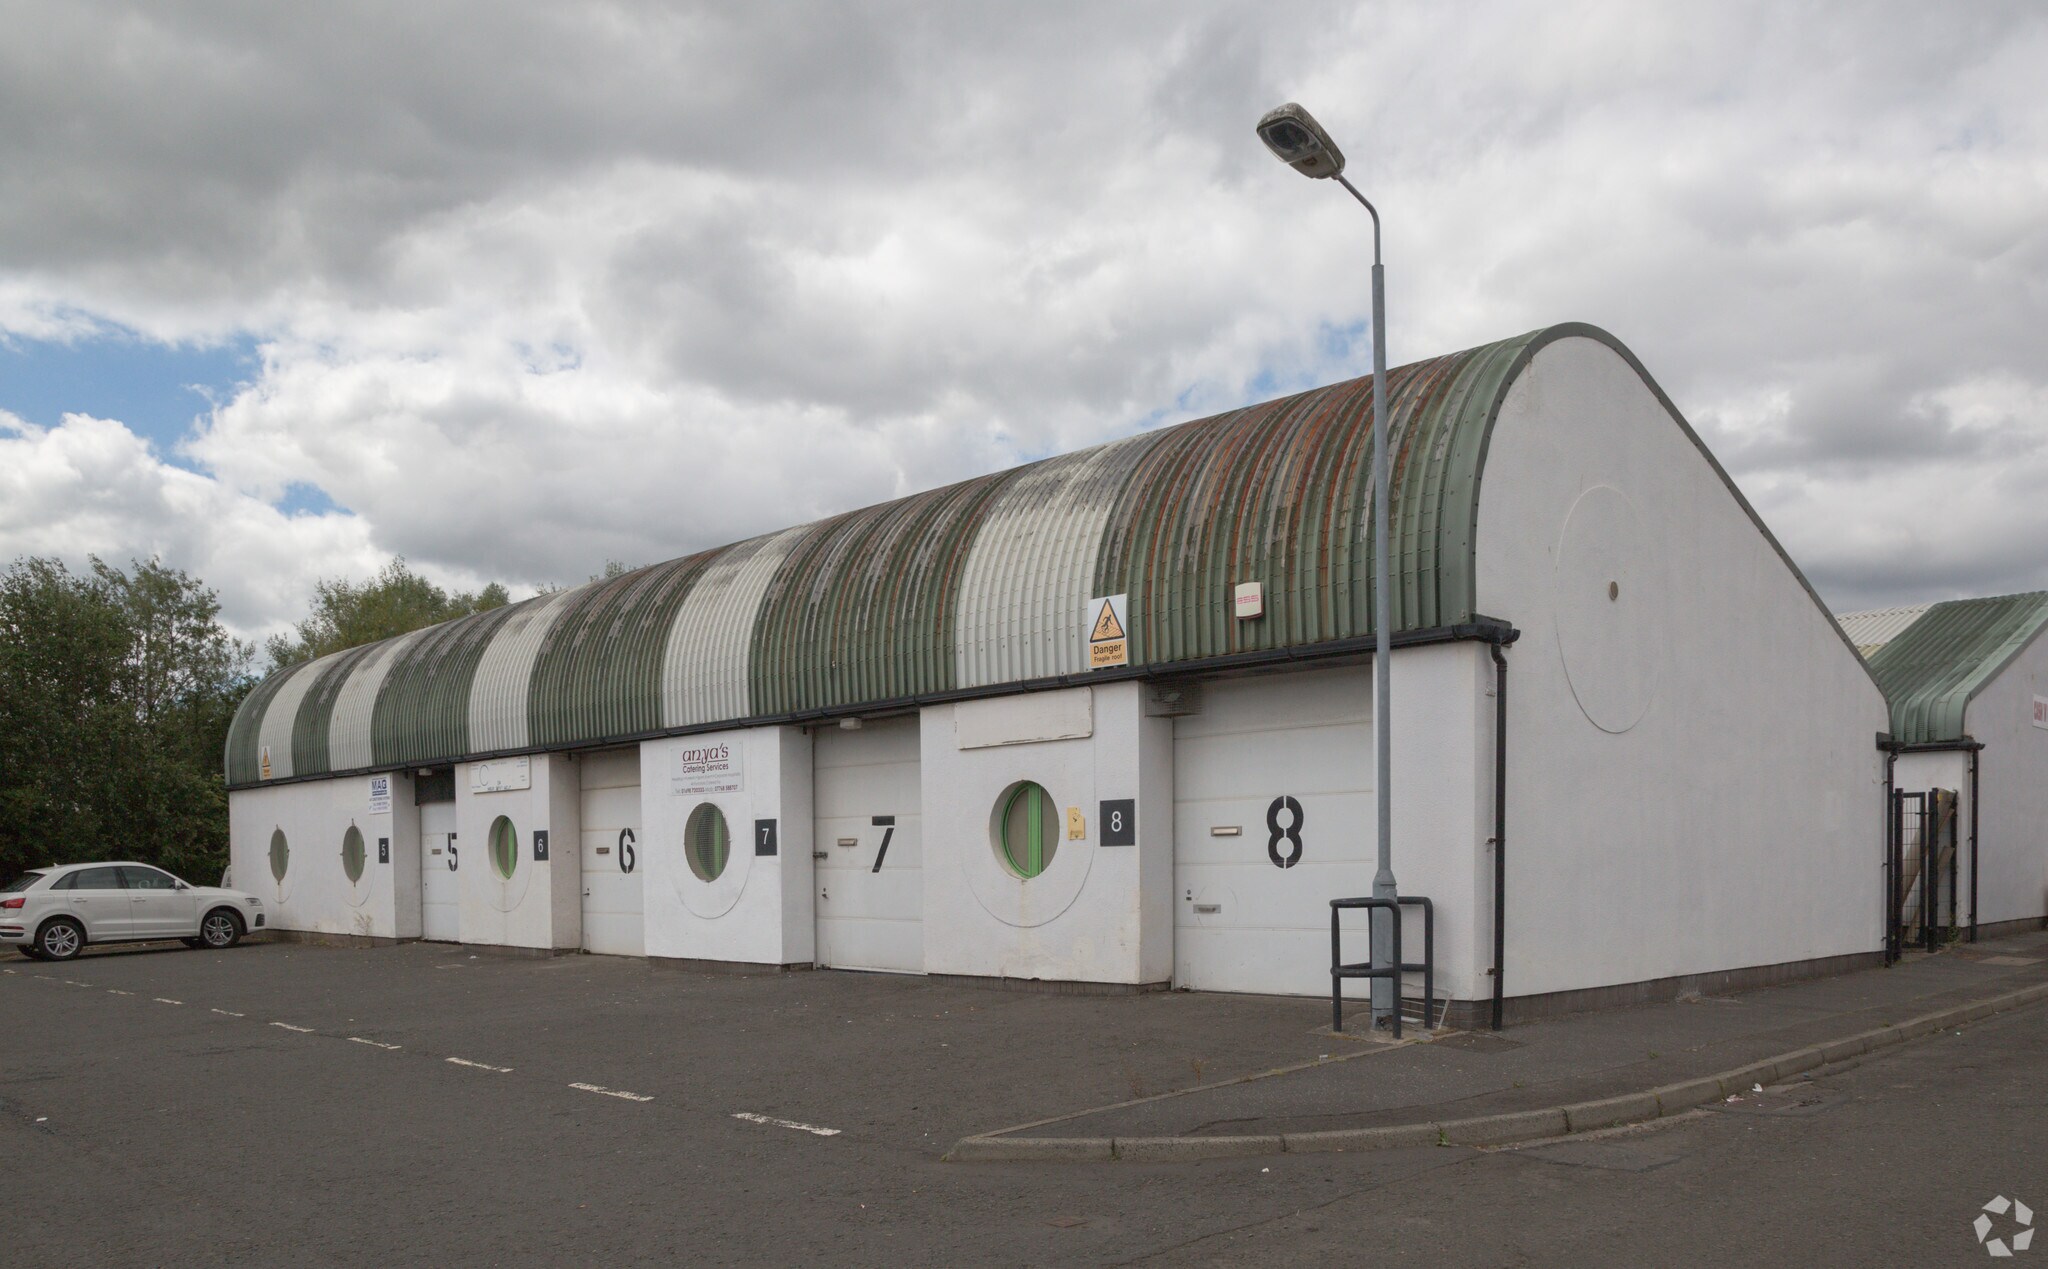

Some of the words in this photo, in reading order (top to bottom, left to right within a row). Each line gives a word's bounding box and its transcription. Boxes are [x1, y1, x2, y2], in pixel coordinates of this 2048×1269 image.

[1093, 644, 1122, 655] Danger
[1093, 655, 1110, 663] Fragile
[682, 742, 729, 765] anya's
[682, 764, 706, 774] Catering
[706, 763, 729, 772] Services
[1111, 810, 1122, 832] 8
[762, 828, 769, 845] 7
[1266, 795, 1304, 869] 8
[381, 844, 386, 856] 5
[447, 832, 458, 872] 5
[537, 838, 544, 853] 6
[618, 827, 636, 874] 6
[871, 815, 895, 873] 7
